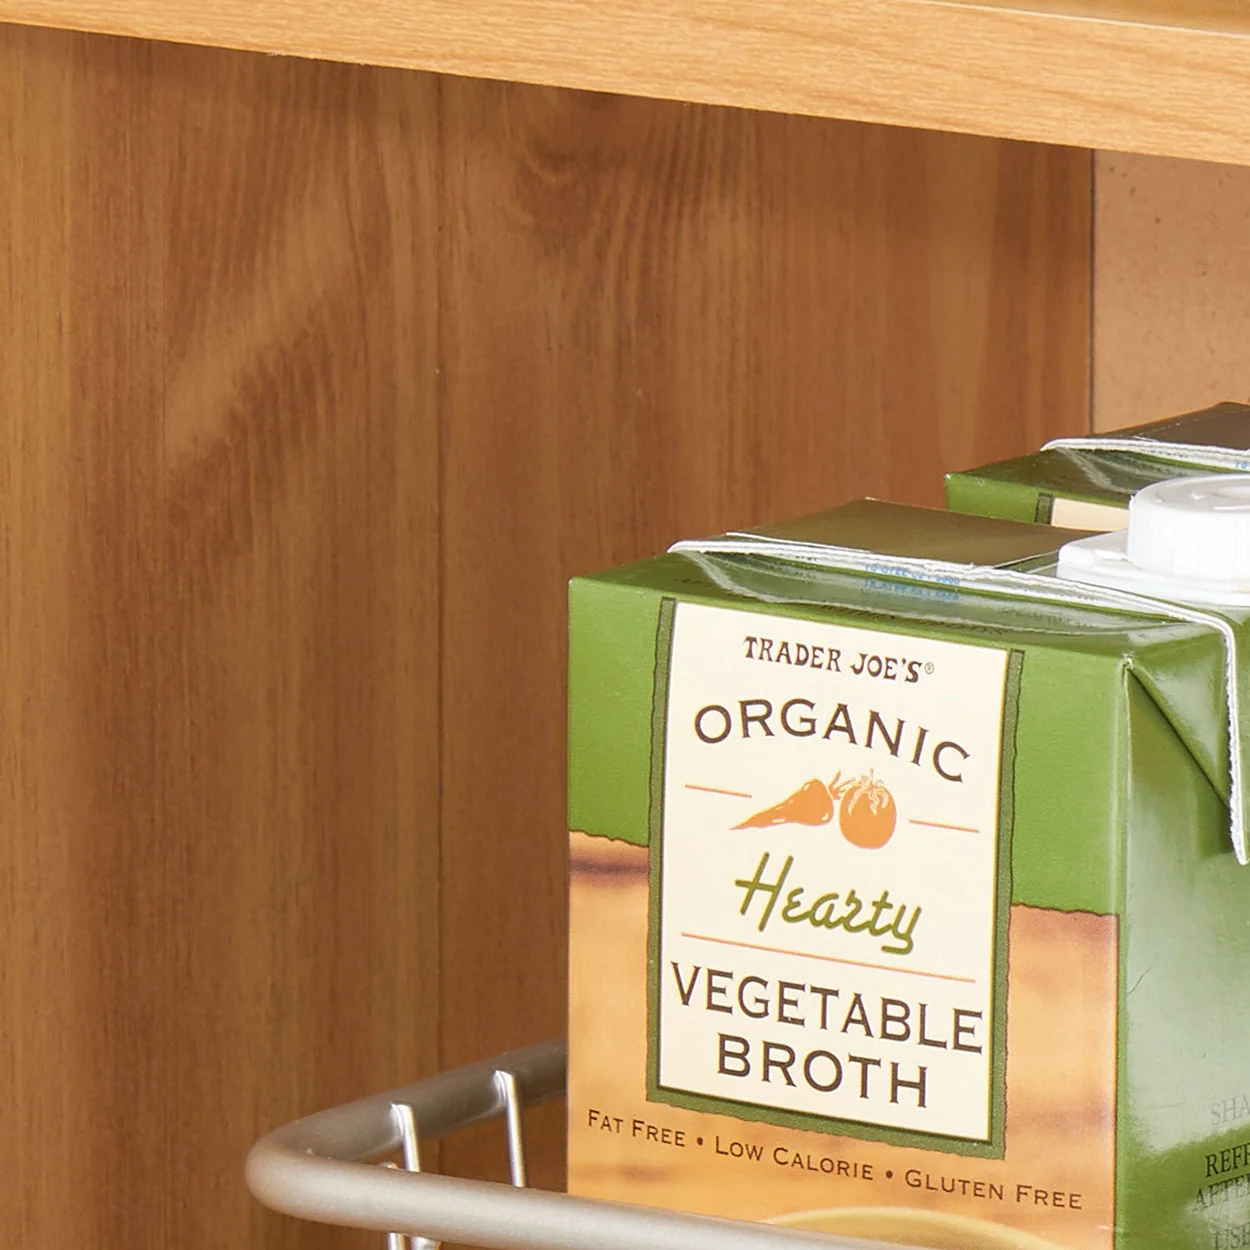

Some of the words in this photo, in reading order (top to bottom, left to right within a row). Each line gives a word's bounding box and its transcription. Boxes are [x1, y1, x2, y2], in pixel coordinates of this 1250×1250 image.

[743, 635, 841, 674] TRADER
[693, 698, 971, 784] ORGANIC
[734, 851, 922, 956] Hearty
[670, 960, 984, 1055] VEGETABLE
[717, 1032, 928, 1109] BROTH
[586, 1109, 623, 1136] FAT
[631, 1119, 686, 1148] FREE
[715, 1135, 764, 1162] LOW
[773, 1146, 874, 1182] CALORIE
[904, 1169, 1005, 1202] GLUTEN
[1015, 1184, 1084, 1211] FREE
